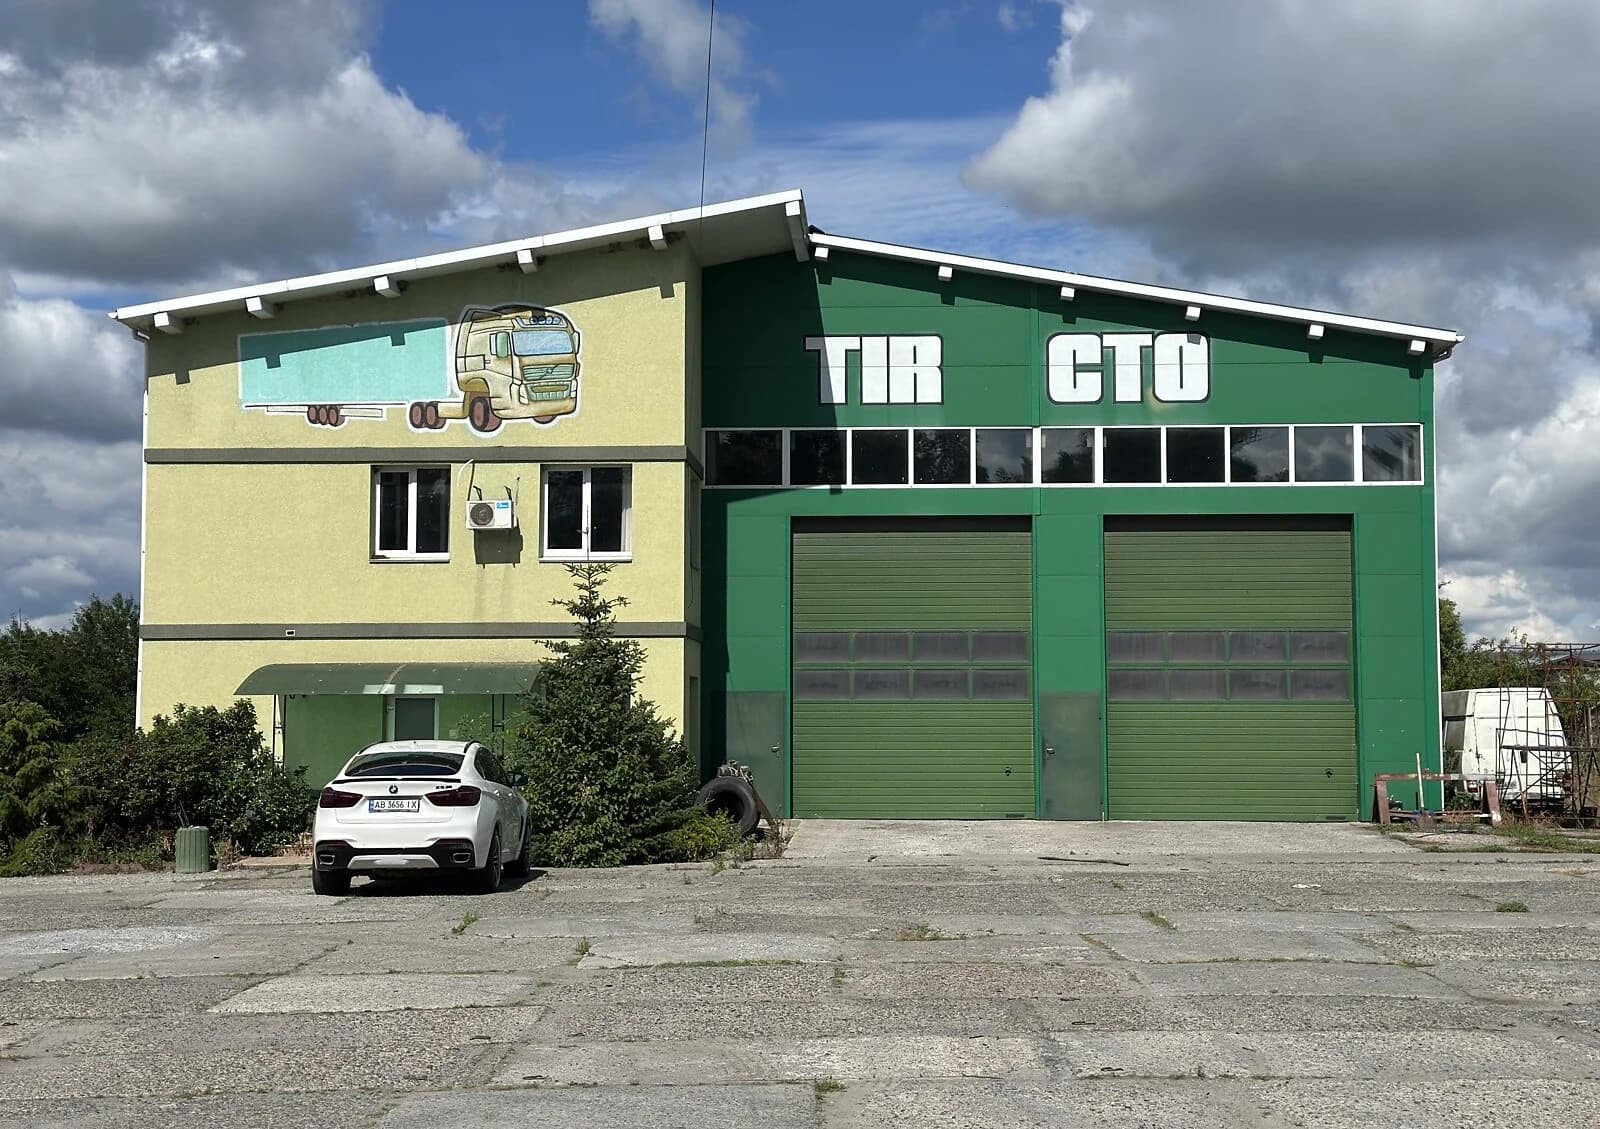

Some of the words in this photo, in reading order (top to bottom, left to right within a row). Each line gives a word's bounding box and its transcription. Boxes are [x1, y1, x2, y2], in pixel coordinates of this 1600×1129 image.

[804, 335, 943, 405] TIR
[1047, 332, 1210, 403] СТО
[374, 801, 386, 809] AB
[388, 801, 404, 809] 3656
